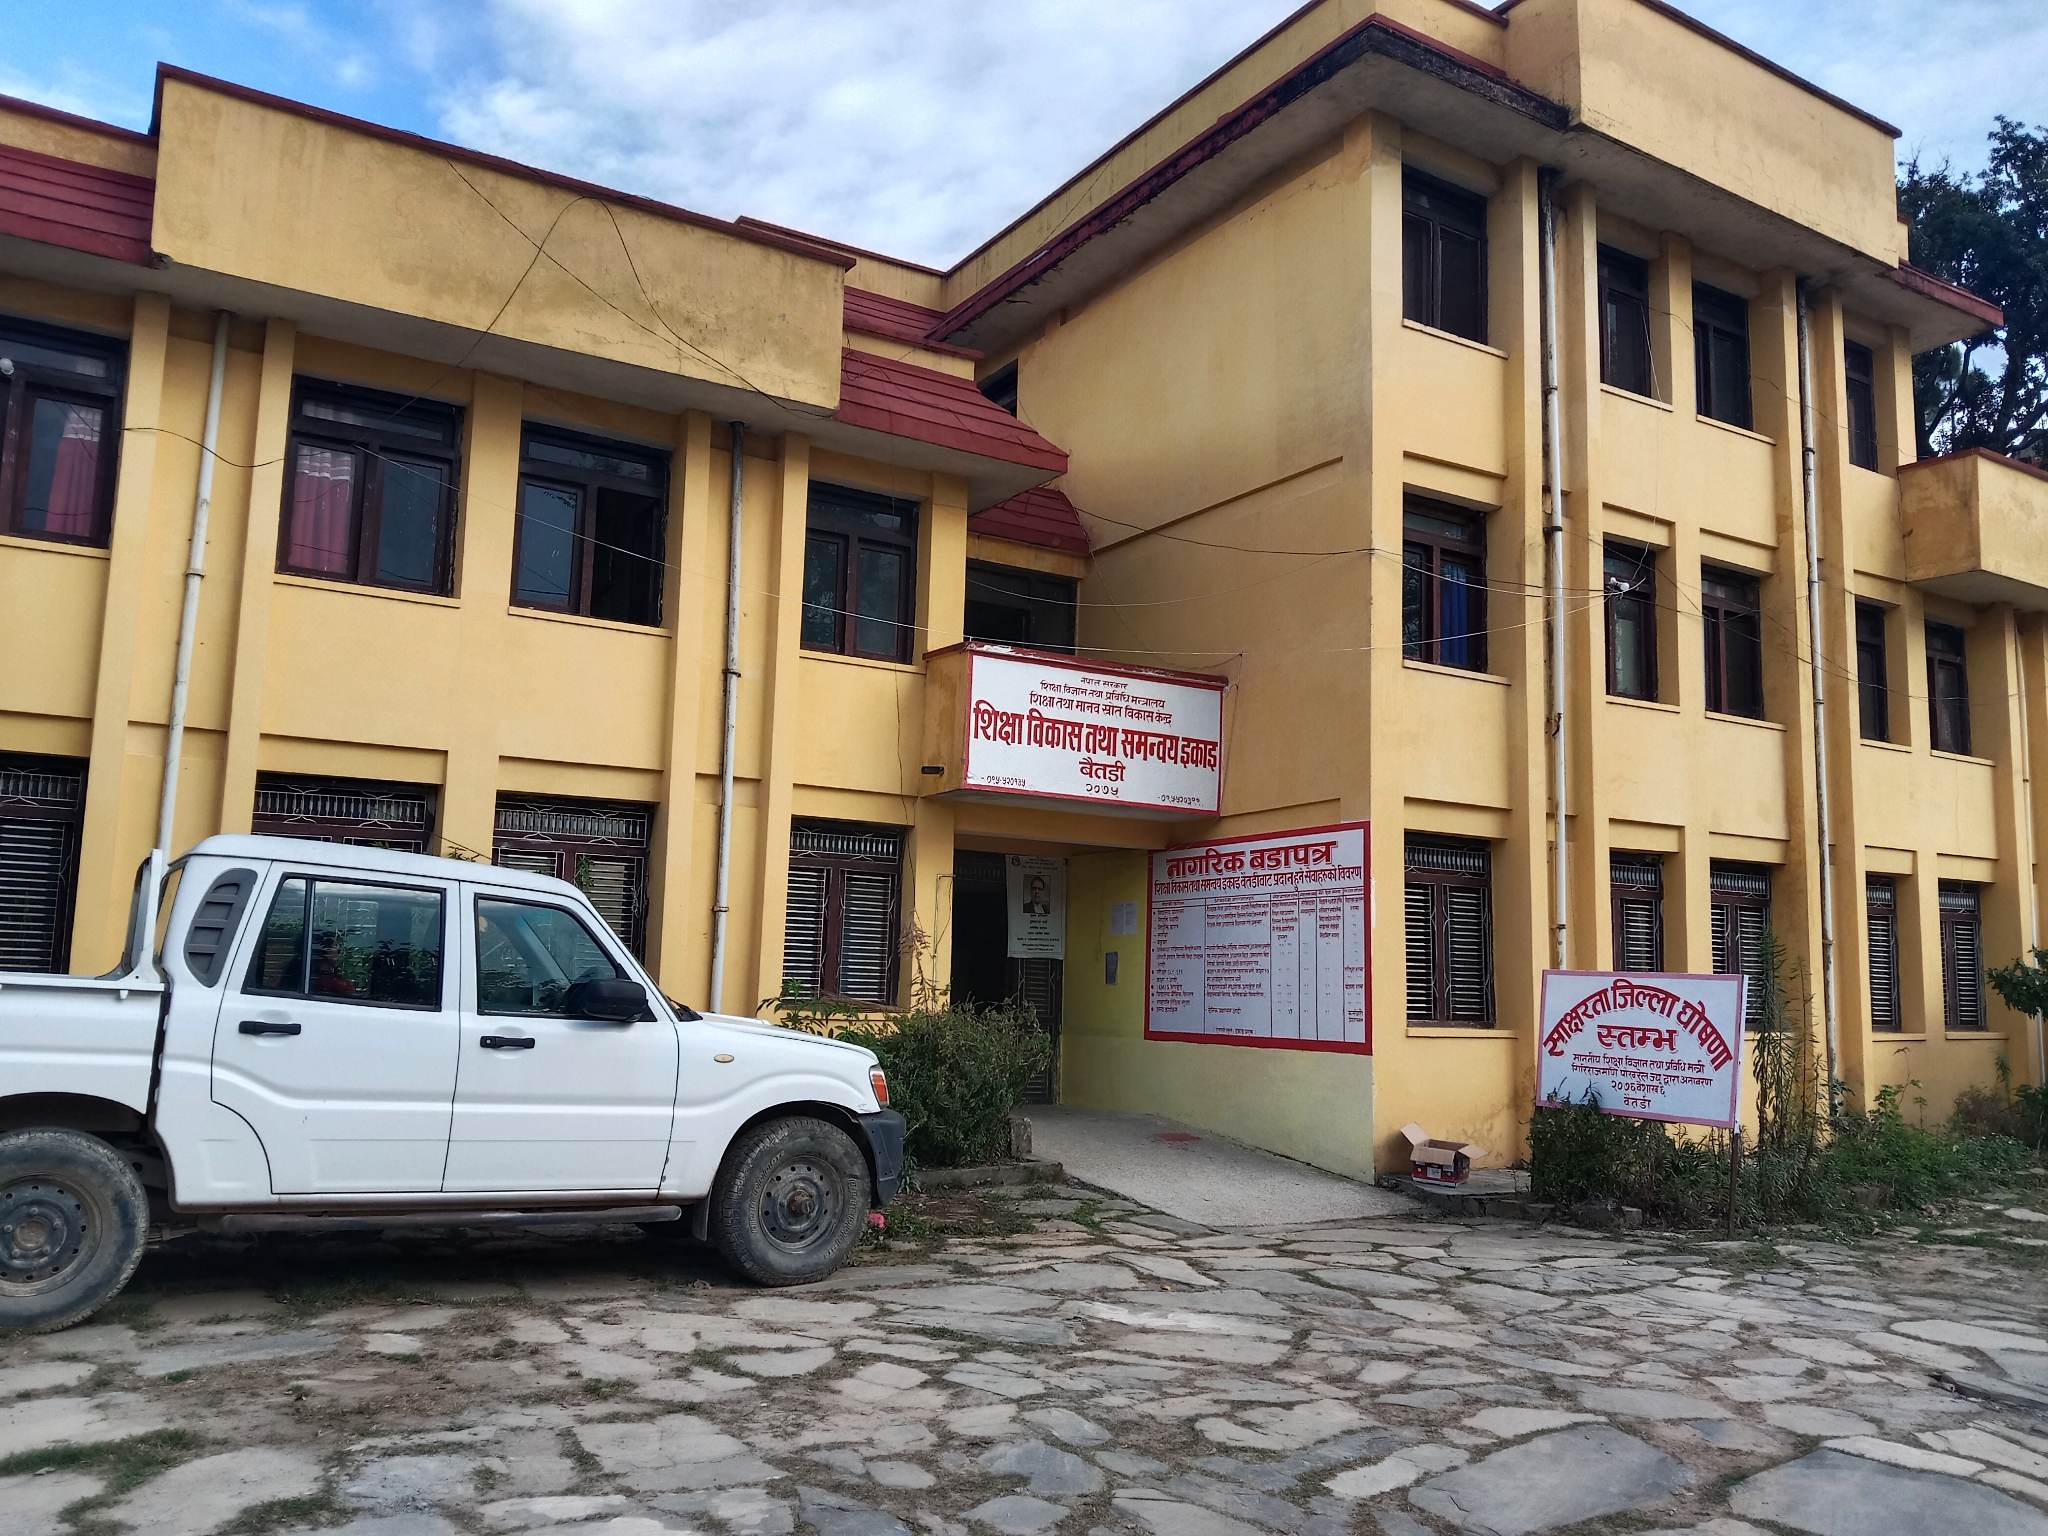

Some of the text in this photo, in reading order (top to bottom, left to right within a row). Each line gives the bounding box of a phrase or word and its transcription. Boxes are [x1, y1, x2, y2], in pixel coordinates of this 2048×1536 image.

[1088, 689, 1104, 699] तथा
[1102, 680, 1128, 690] सरकार
[1029, 690, 1056, 707] शिक्षा
[1056, 698, 1075, 711] तथा
[1075, 700, 1101, 715] मानव
[1124, 705, 1155, 723] विकास
[973, 700, 1025, 746] शिक्षा
[1027, 708, 1085, 752] विकास
[1085, 724, 1119, 757] तथा
[1121, 729, 1180, 765] समन्वय
[1079, 757, 1126, 782] बैतडी
[1085, 783, 1119, 798] २०७५
[1166, 840, 1338, 879] नागरिक बडापत्र
[1154, 879, 1171, 895] शिक्षा
[1171, 878, 1189, 894] विकास
[1189, 878, 1201, 892] तथा
[1201, 877, 1221, 892] समन्वय
[1273, 872, 1294, 886] प्रदान
[1338, 865, 1362, 880] विवरण
[1543, 978, 1734, 1072] साक्षरता जिल्ला घोषणा
[1597, 1024, 1678, 1053] स्तम्भ
[1602, 1053, 1624, 1068] शिक्षा
[1625, 1055, 1648, 1069] विज्ञान
[1649, 1060, 1664, 1071] तथा
[1665, 1059, 1687, 1072] प्रविधि
[1687, 1060, 1705, 1074] मन्त्री
